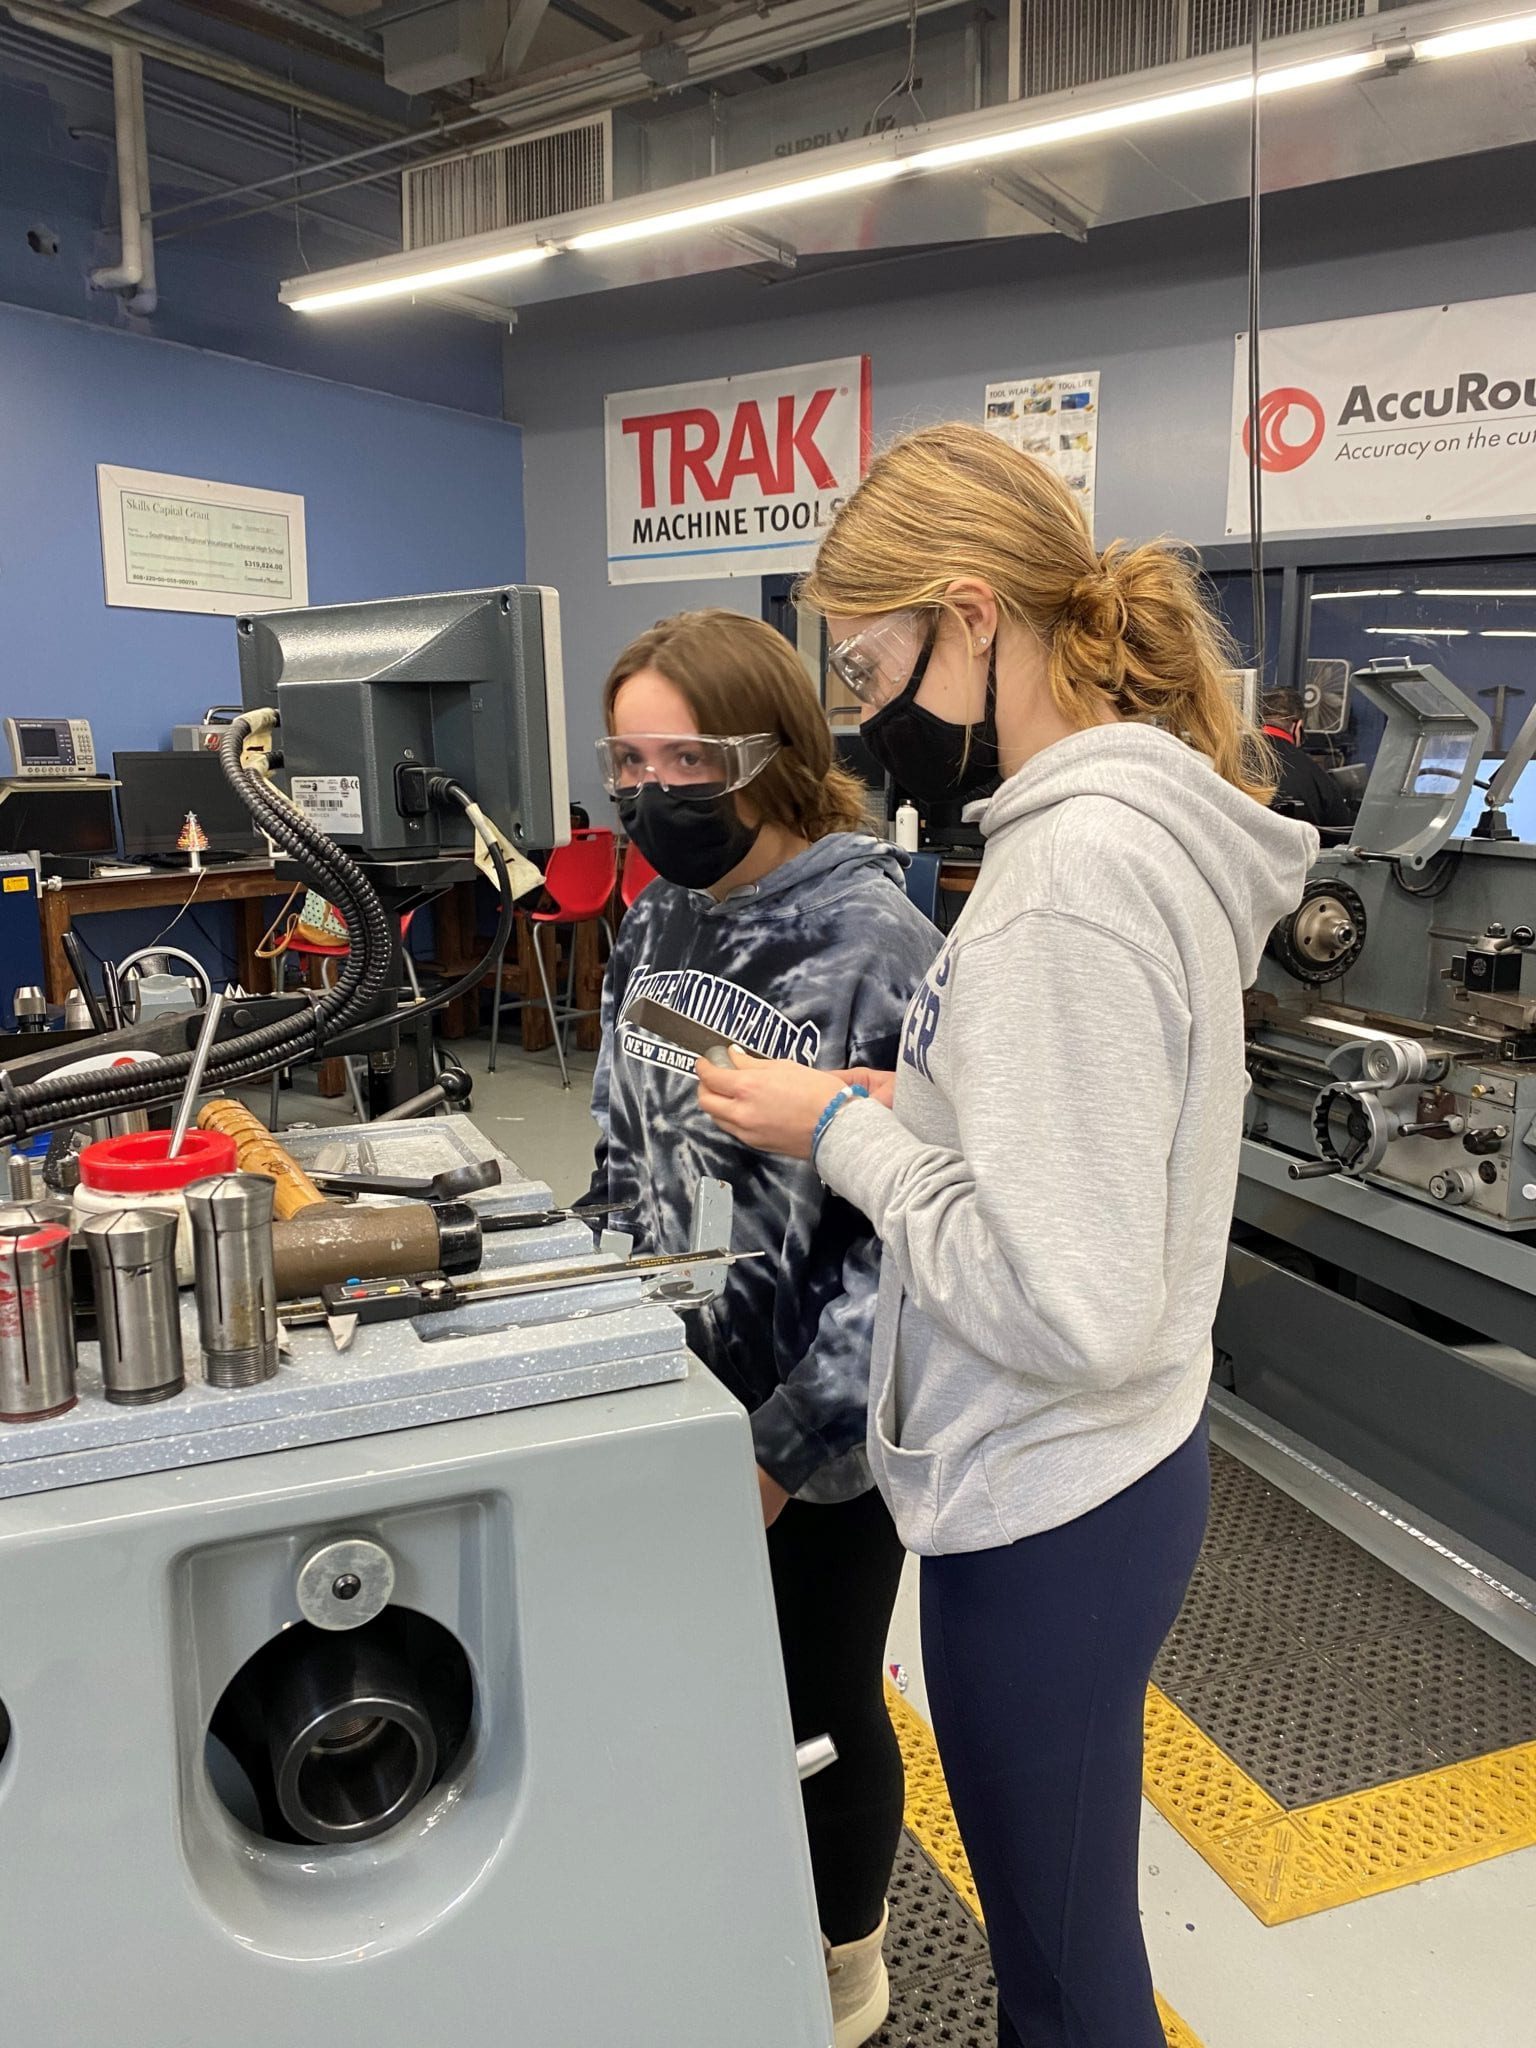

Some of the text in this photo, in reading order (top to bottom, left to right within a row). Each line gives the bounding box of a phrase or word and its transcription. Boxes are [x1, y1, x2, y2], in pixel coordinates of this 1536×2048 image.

[990, 378, 1093, 399] TOOL WEAR TOOL LIFE
[621, 387, 839, 509] TRAK
[1335, 438, 1430, 462] Accuracy
[1434, 439, 1460, 452] on
[1467, 426, 1501, 449] the
[126, 498, 210, 520] Skills Capital Grant
[632, 508, 748, 544] MACHINE
[625, 1036, 656, 1059] NEW
